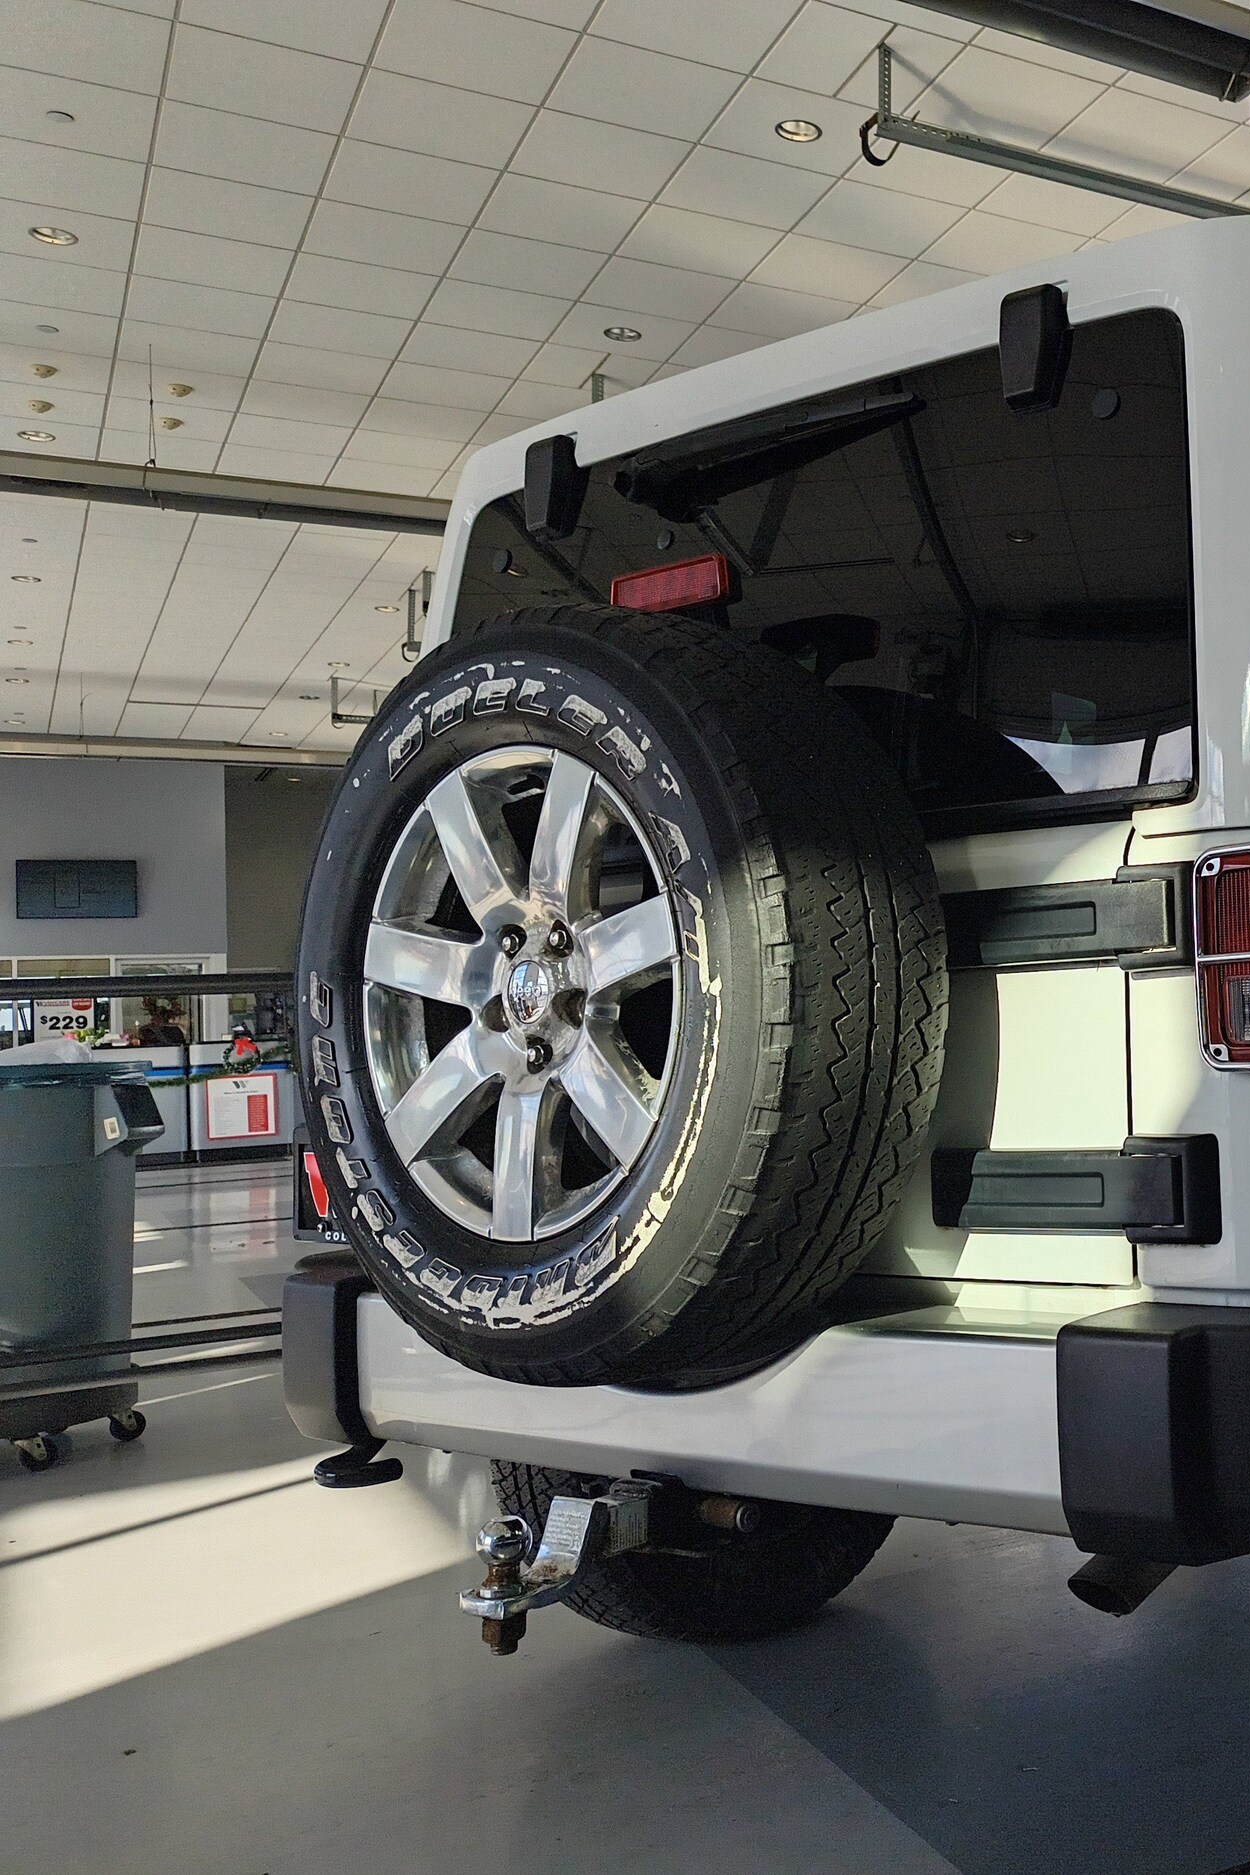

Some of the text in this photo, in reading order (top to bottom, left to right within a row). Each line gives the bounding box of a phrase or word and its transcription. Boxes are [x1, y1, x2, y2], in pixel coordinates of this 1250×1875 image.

[387, 676, 648, 782] DUELER
[512, 982, 543, 1001] Jeep
[40, 1015, 88, 1031] $229
[310, 970, 620, 1308] BRIDGESTONE
